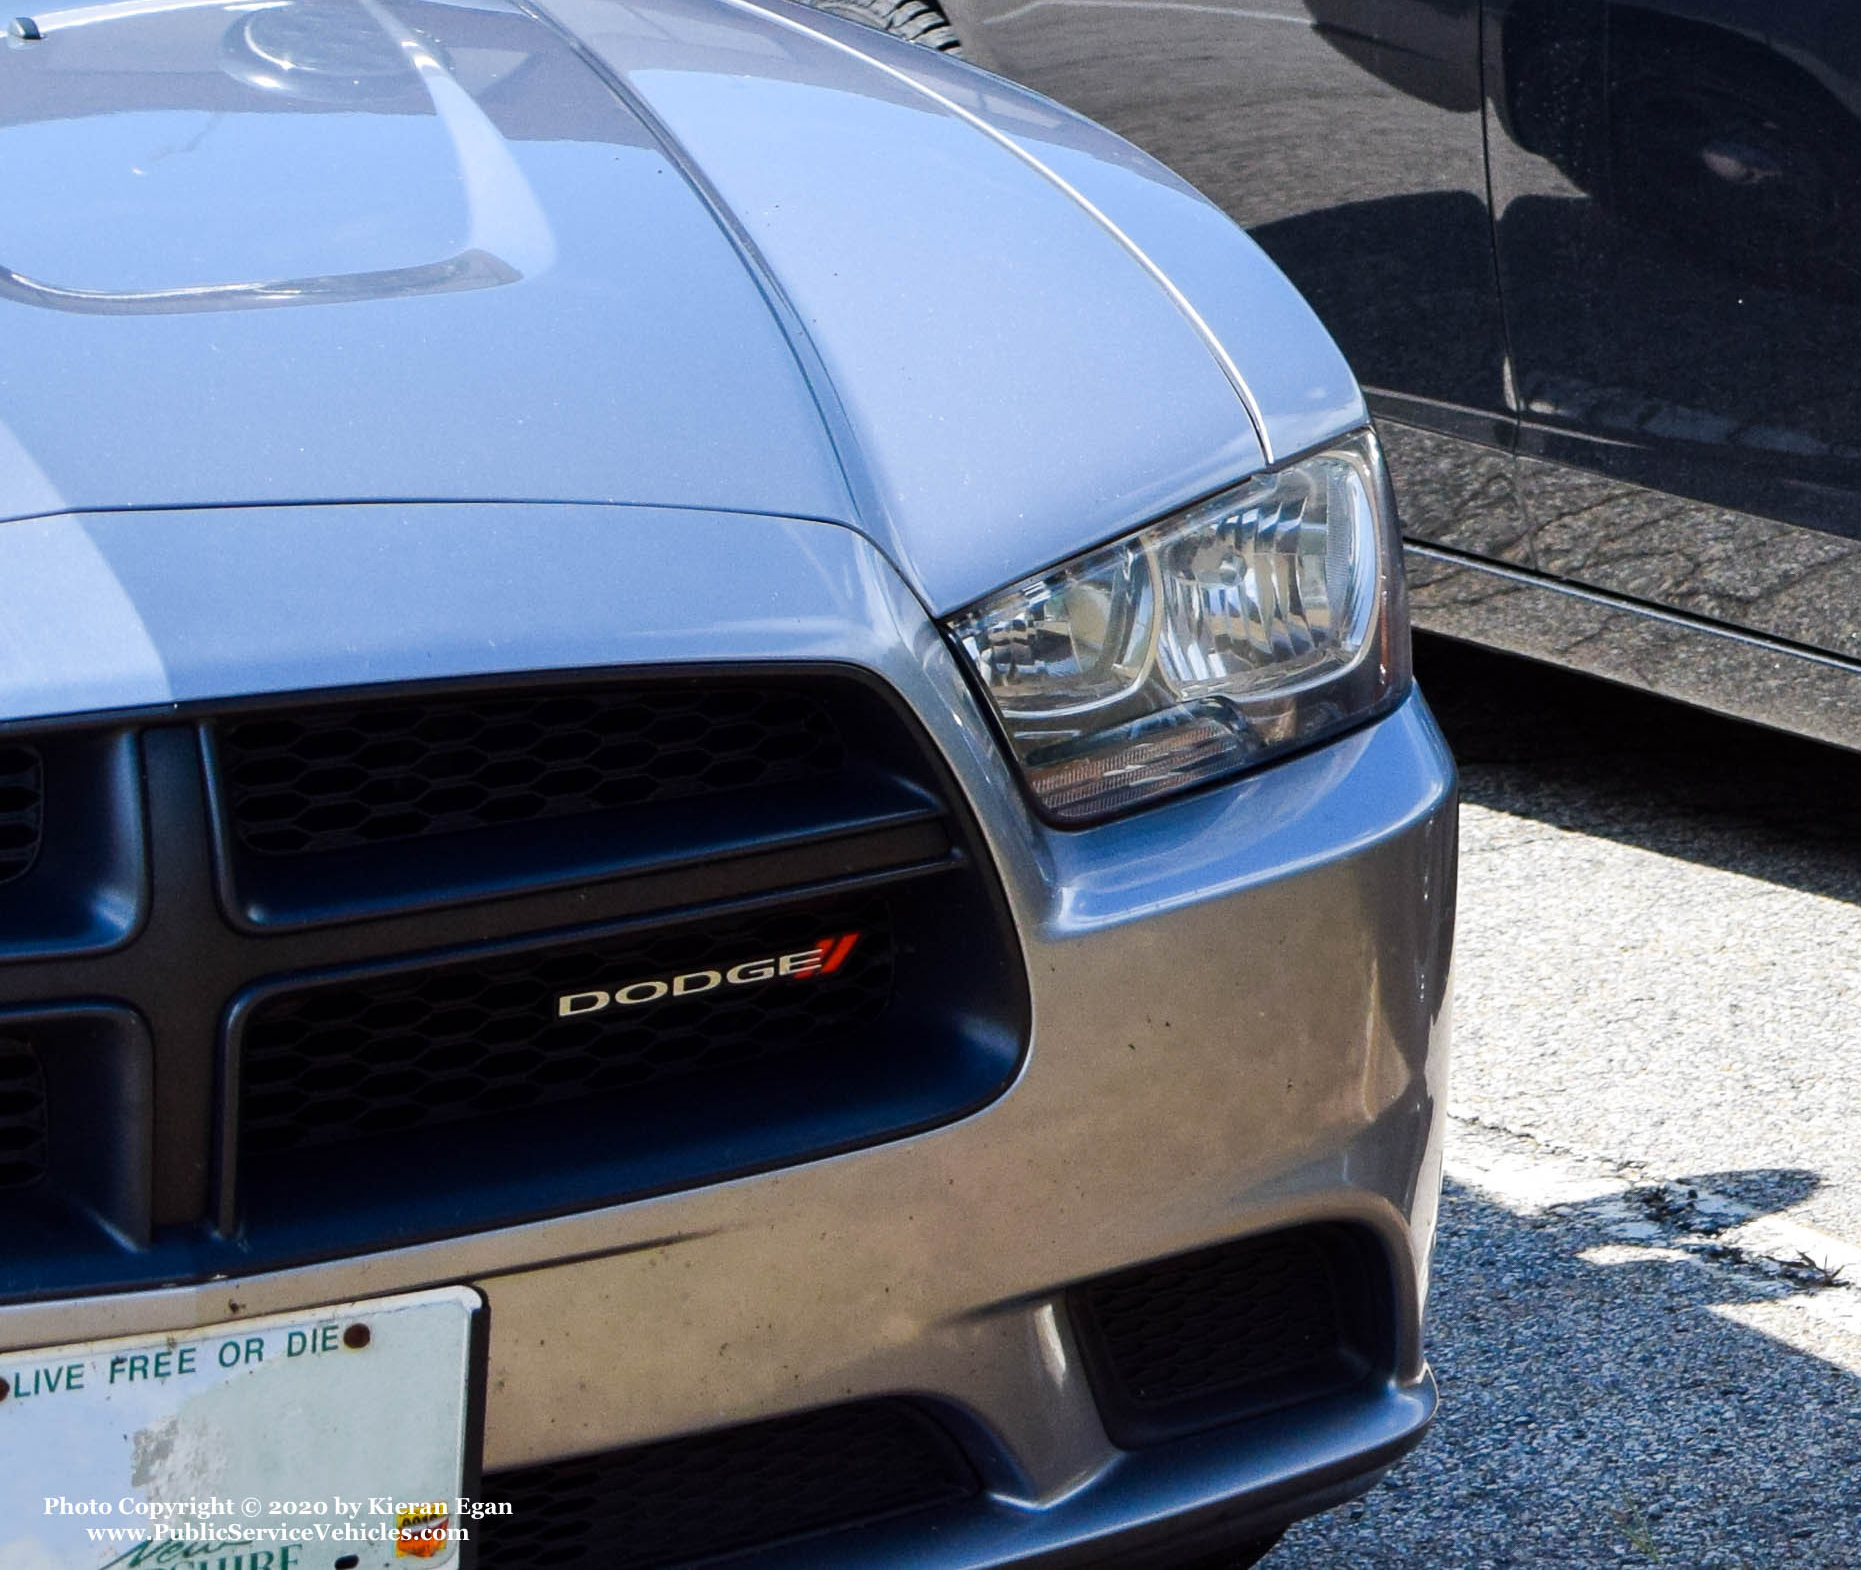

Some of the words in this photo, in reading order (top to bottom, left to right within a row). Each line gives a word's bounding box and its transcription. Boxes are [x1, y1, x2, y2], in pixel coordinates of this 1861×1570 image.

[558, 947, 824, 1017] DODGE
[14, 1363, 85, 1398] LIVE
[109, 1347, 197, 1384] FREE
[217, 1336, 265, 1369] OR
[286, 1325, 340, 1358] DIE
